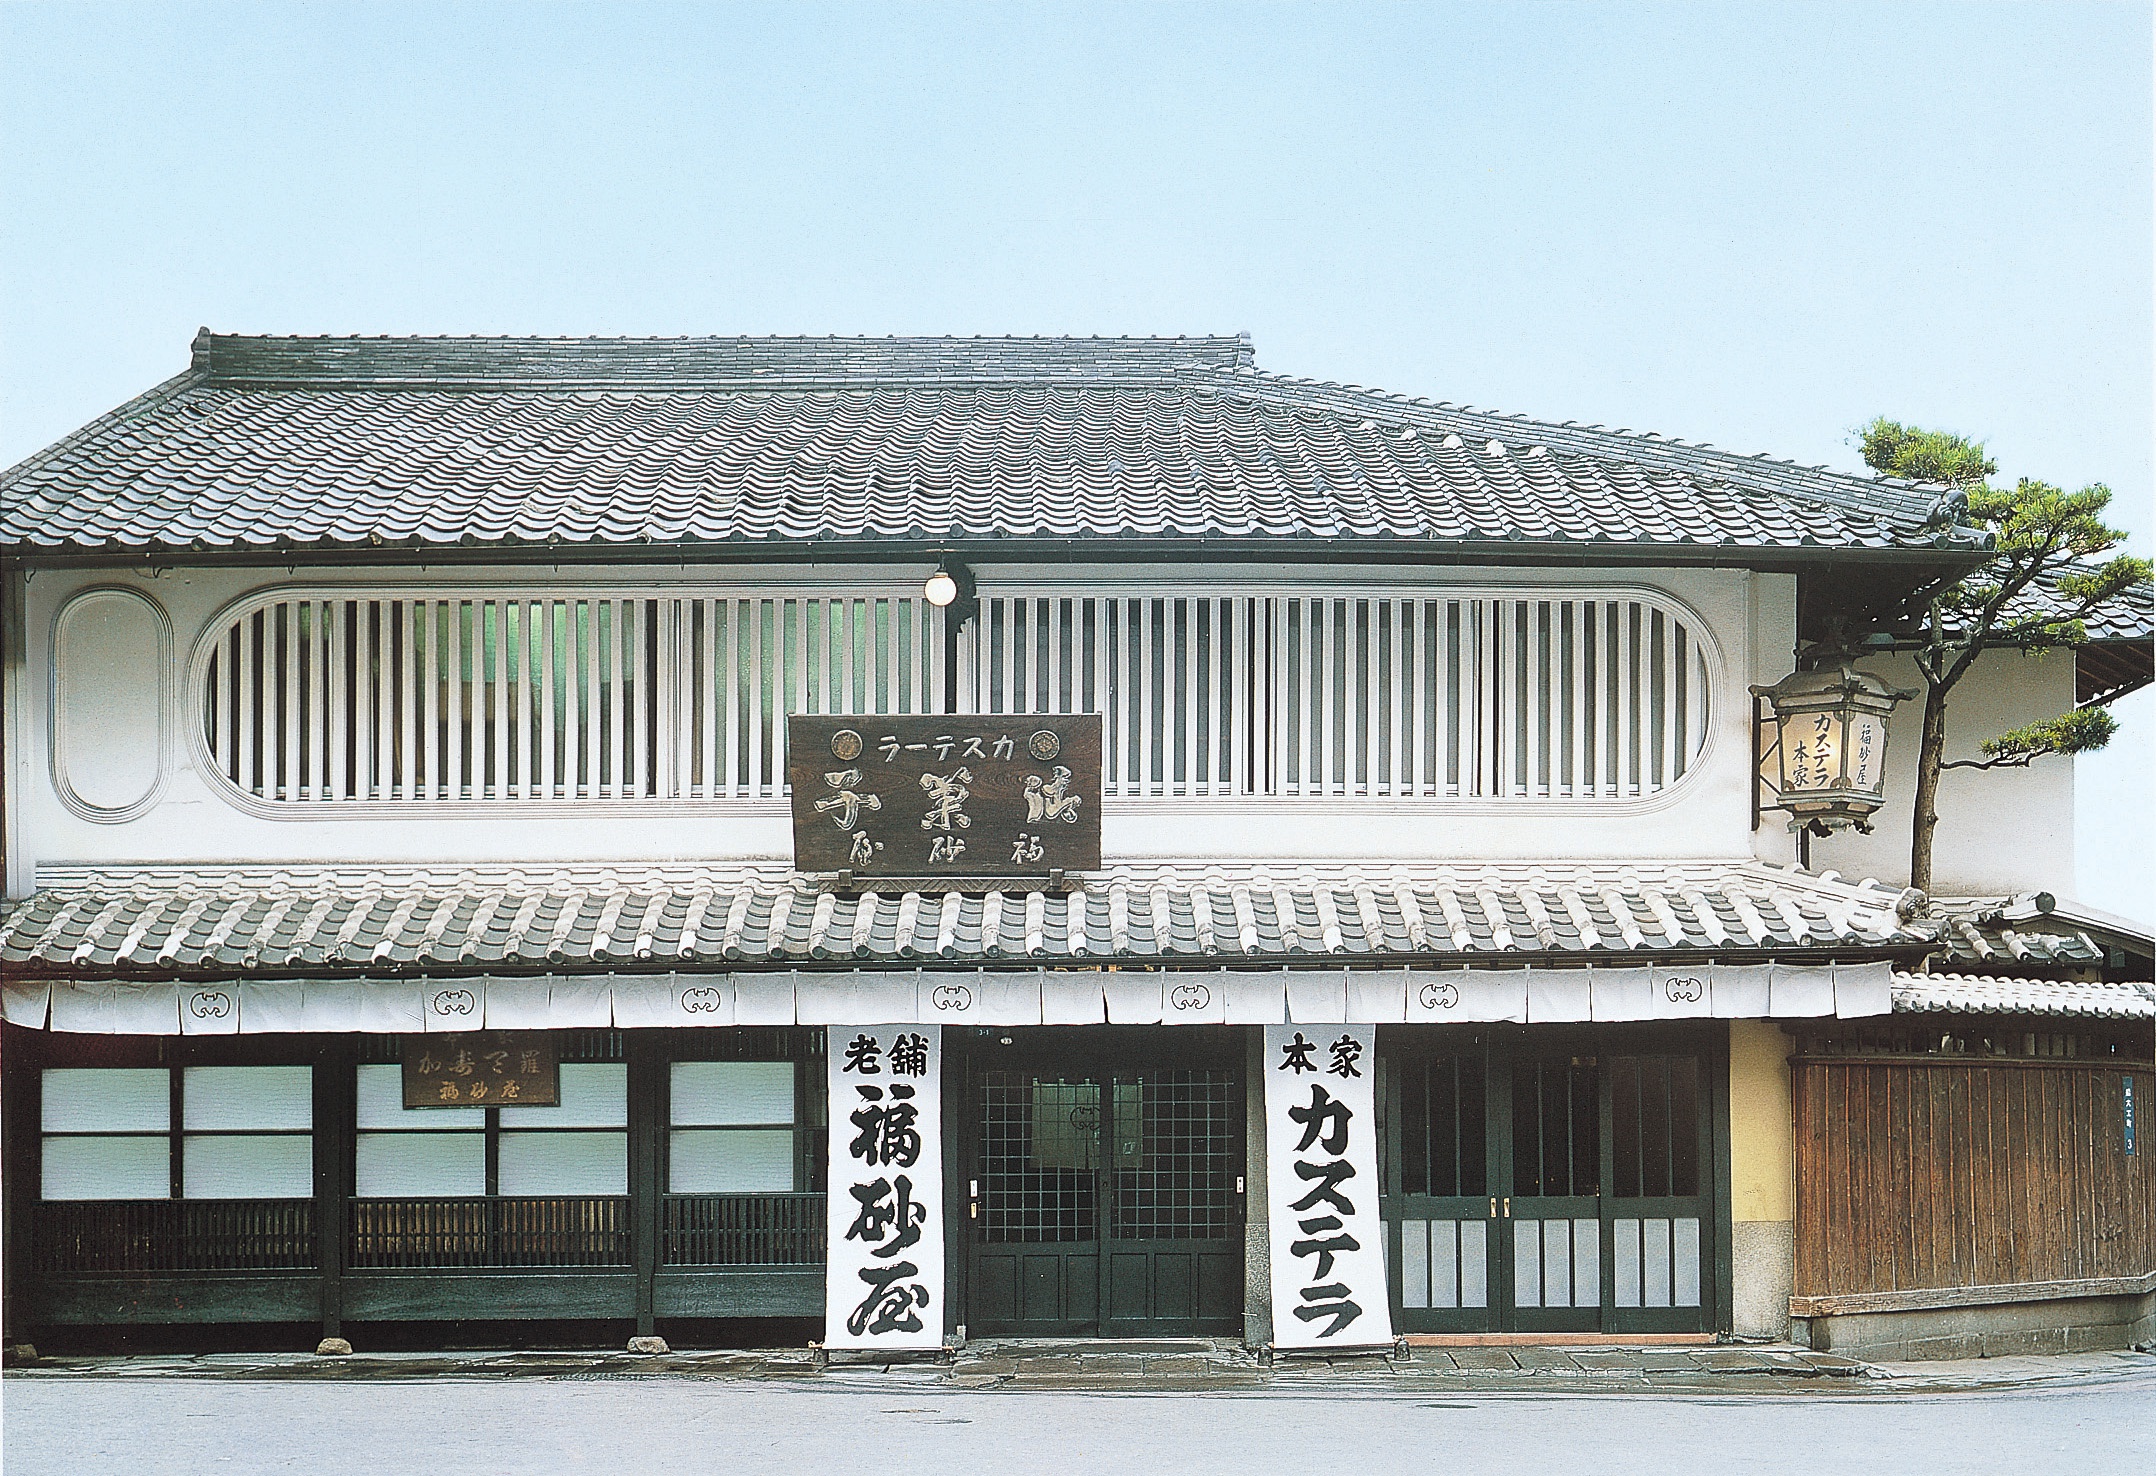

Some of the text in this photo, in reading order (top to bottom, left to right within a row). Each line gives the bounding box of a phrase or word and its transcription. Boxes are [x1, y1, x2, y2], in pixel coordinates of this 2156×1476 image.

[1792, 740, 1810, 788] 本家
[1813, 713, 1831, 788] カステラ
[1856, 723, 1872, 786] 福砂屋
[842, 1032, 929, 1079] 老舗
[1277, 1032, 1363, 1079] 本家
[439, 1080, 520, 1100] 福砂屋
[843, 1083, 930, 1337] 福砂屋
[1286, 1083, 1363, 1339] カステラ
